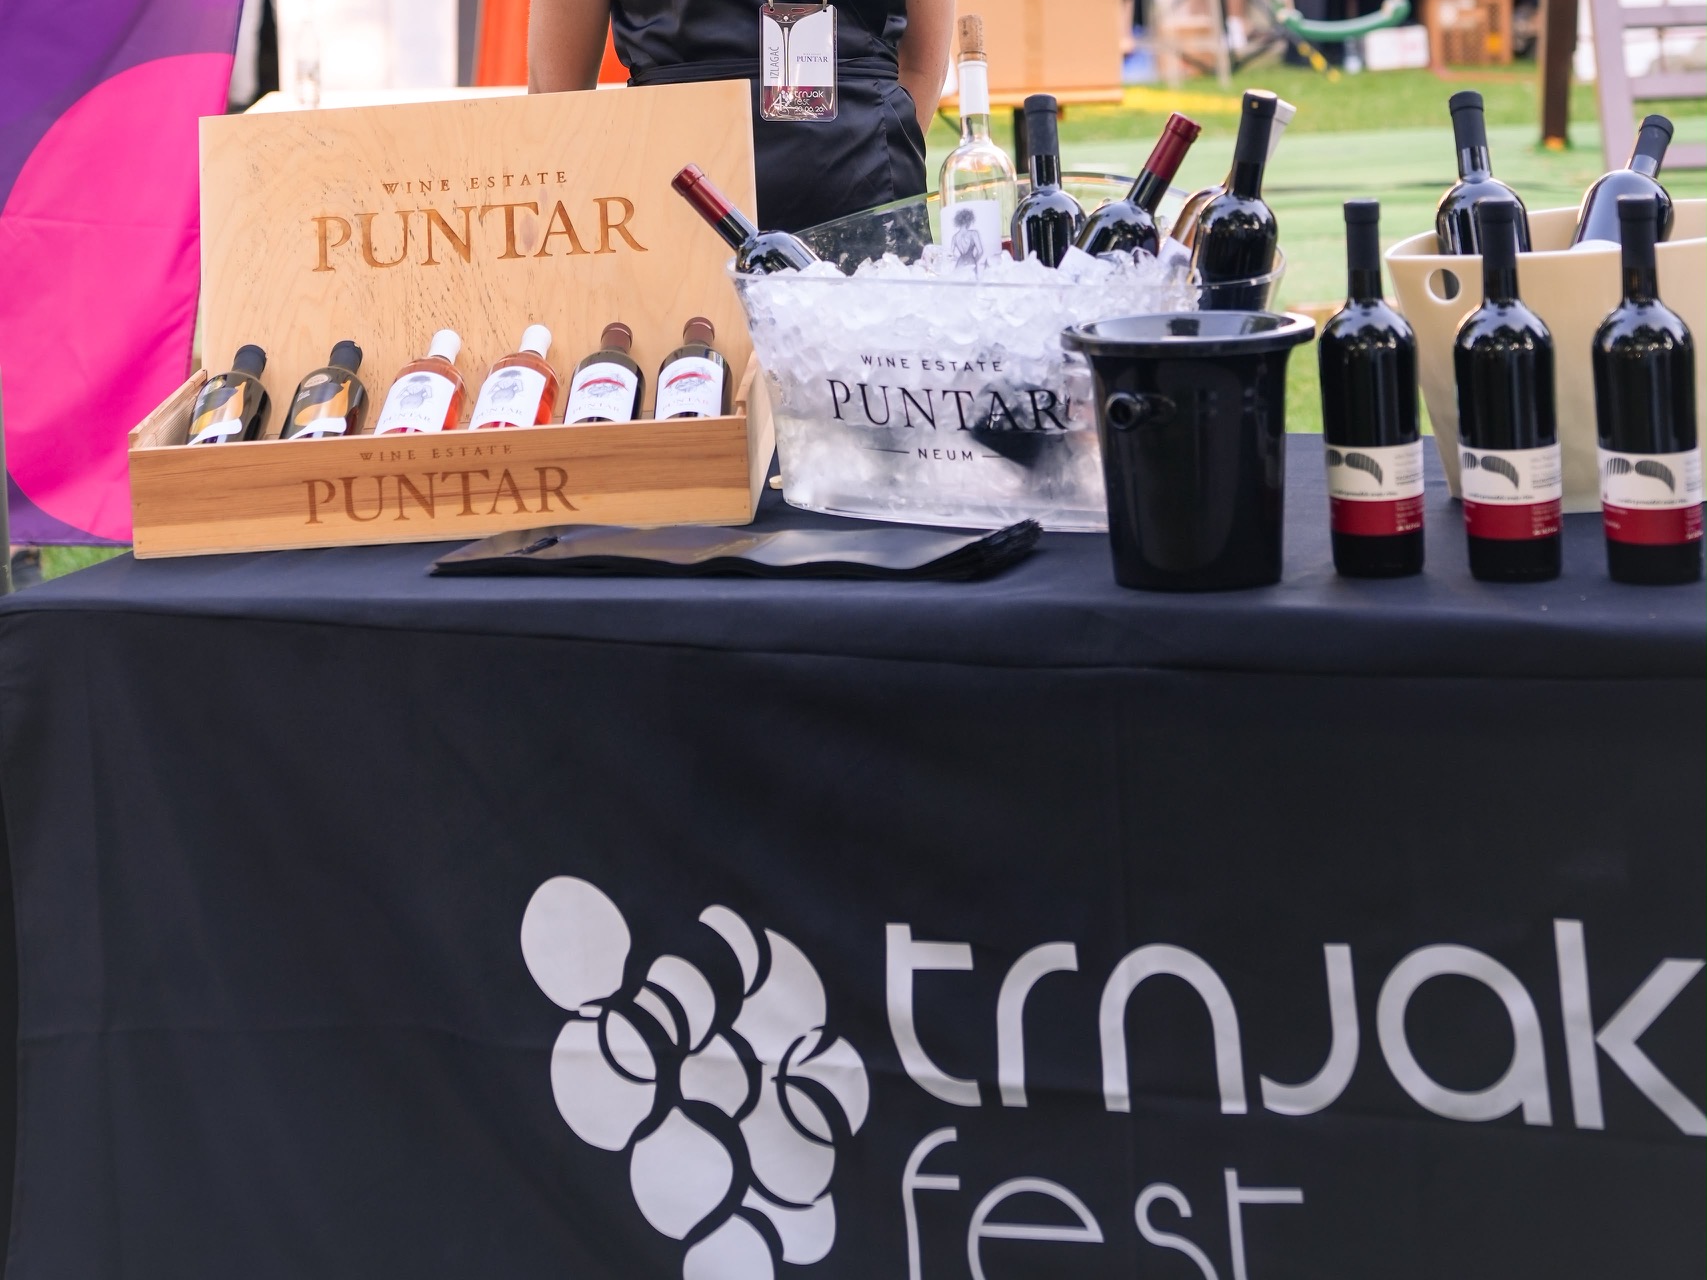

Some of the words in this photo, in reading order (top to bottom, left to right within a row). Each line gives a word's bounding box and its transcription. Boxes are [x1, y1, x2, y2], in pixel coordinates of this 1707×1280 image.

[796, 55, 829, 63] PUNTAR
[382, 179, 451, 195] WINE
[469, 170, 567, 190] ESTATE
[311, 196, 649, 273] PUNTAR
[861, 353, 911, 370] WINE
[921, 358, 1004, 373] ESTATE
[826, 377, 1069, 432] PUNTAR
[359, 448, 417, 463] WINE
[432, 444, 513, 460] ESTATE
[918, 448, 974, 462] NEUM
[302, 466, 580, 526] PUNTAR
[886, 918, 1707, 1137] trnjak
[902, 1127, 1304, 1280] fest
